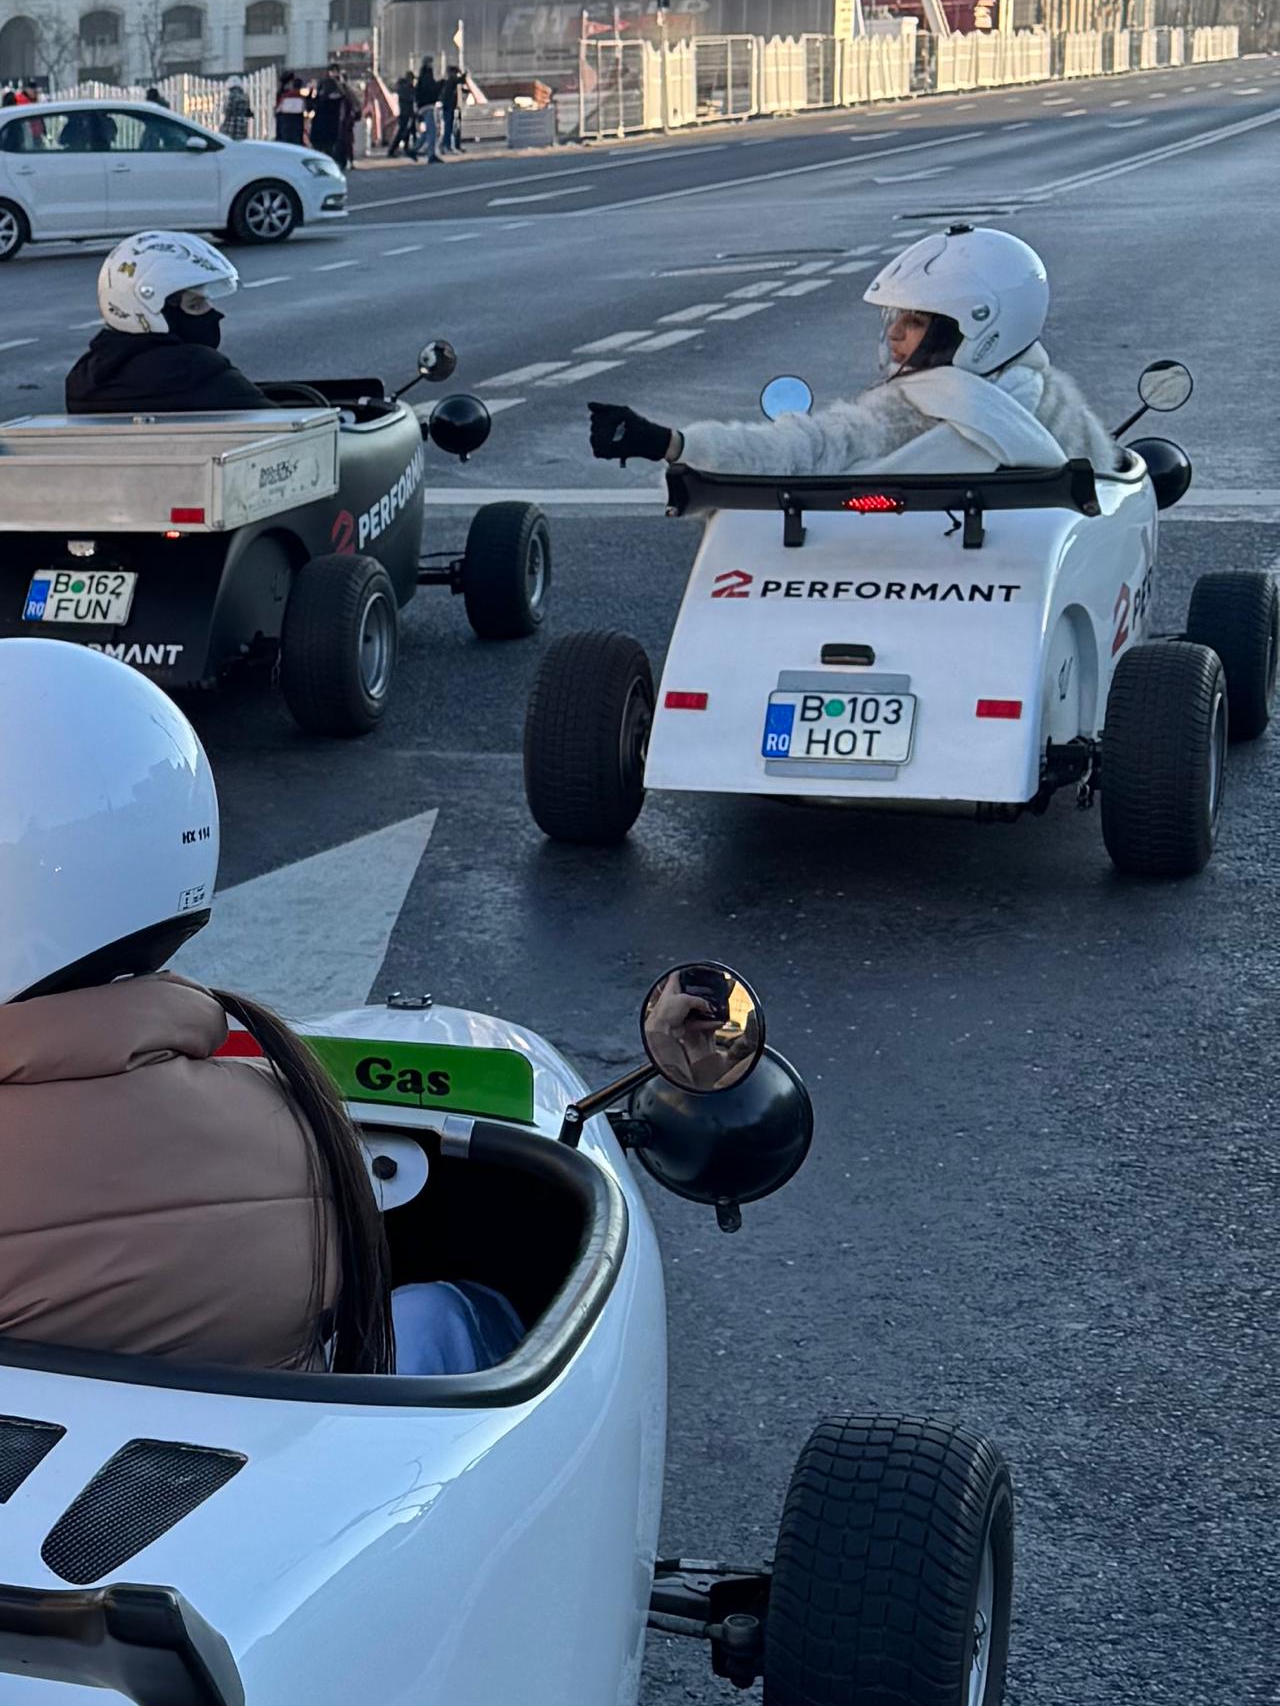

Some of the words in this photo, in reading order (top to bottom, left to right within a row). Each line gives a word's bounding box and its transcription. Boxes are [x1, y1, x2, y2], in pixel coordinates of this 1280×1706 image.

[53, 573, 72, 594] B
[86, 574, 126, 596] 162
[27, 600, 45, 617] RO
[54, 599, 111, 620] FUN
[800, 695, 825, 722] B
[848, 697, 903, 724] 103
[766, 733, 789, 751] RO
[805, 728, 881, 756] HOT
[355, 1056, 451, 1096] Gas
